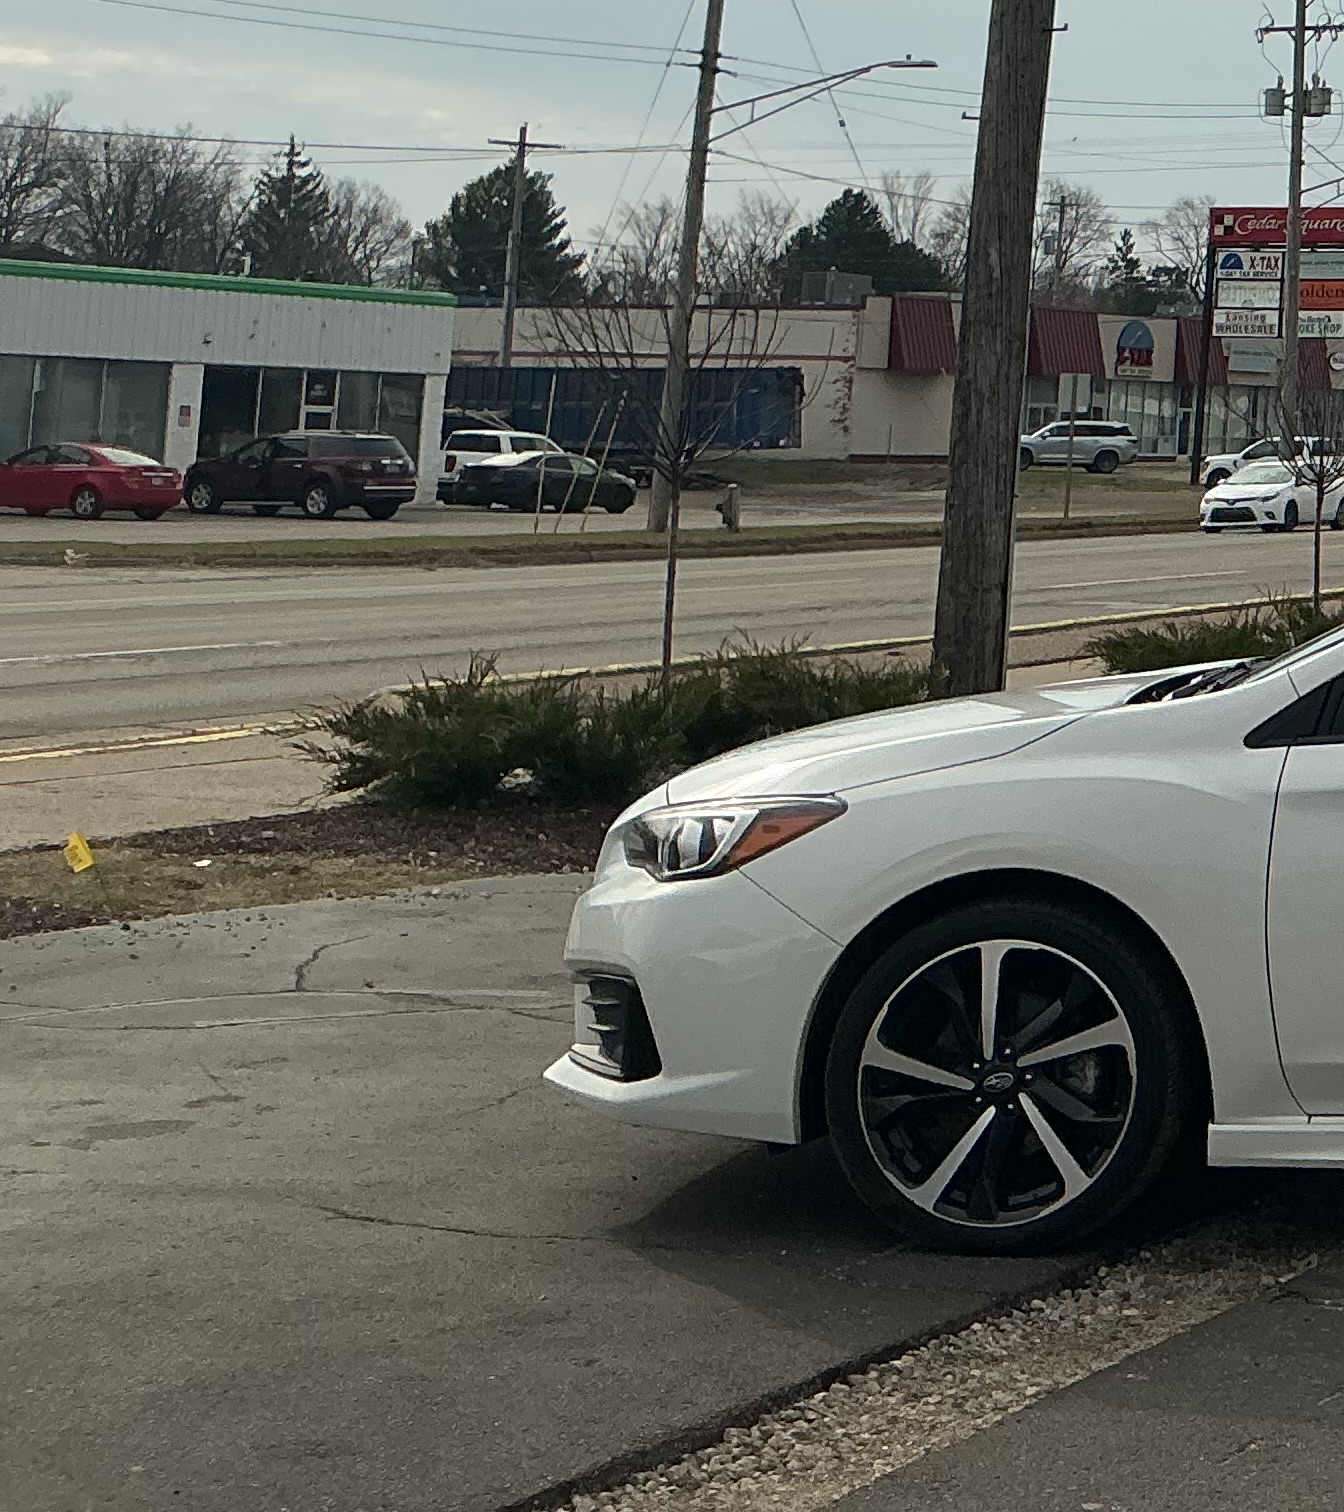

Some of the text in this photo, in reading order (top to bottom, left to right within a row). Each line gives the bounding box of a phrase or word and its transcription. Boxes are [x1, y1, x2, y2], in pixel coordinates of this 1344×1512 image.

[1234, 213, 1285, 236] Cedar
[1297, 283, 1344, 299] olden
[1215, 323, 1276, 335] WHOLESALE
